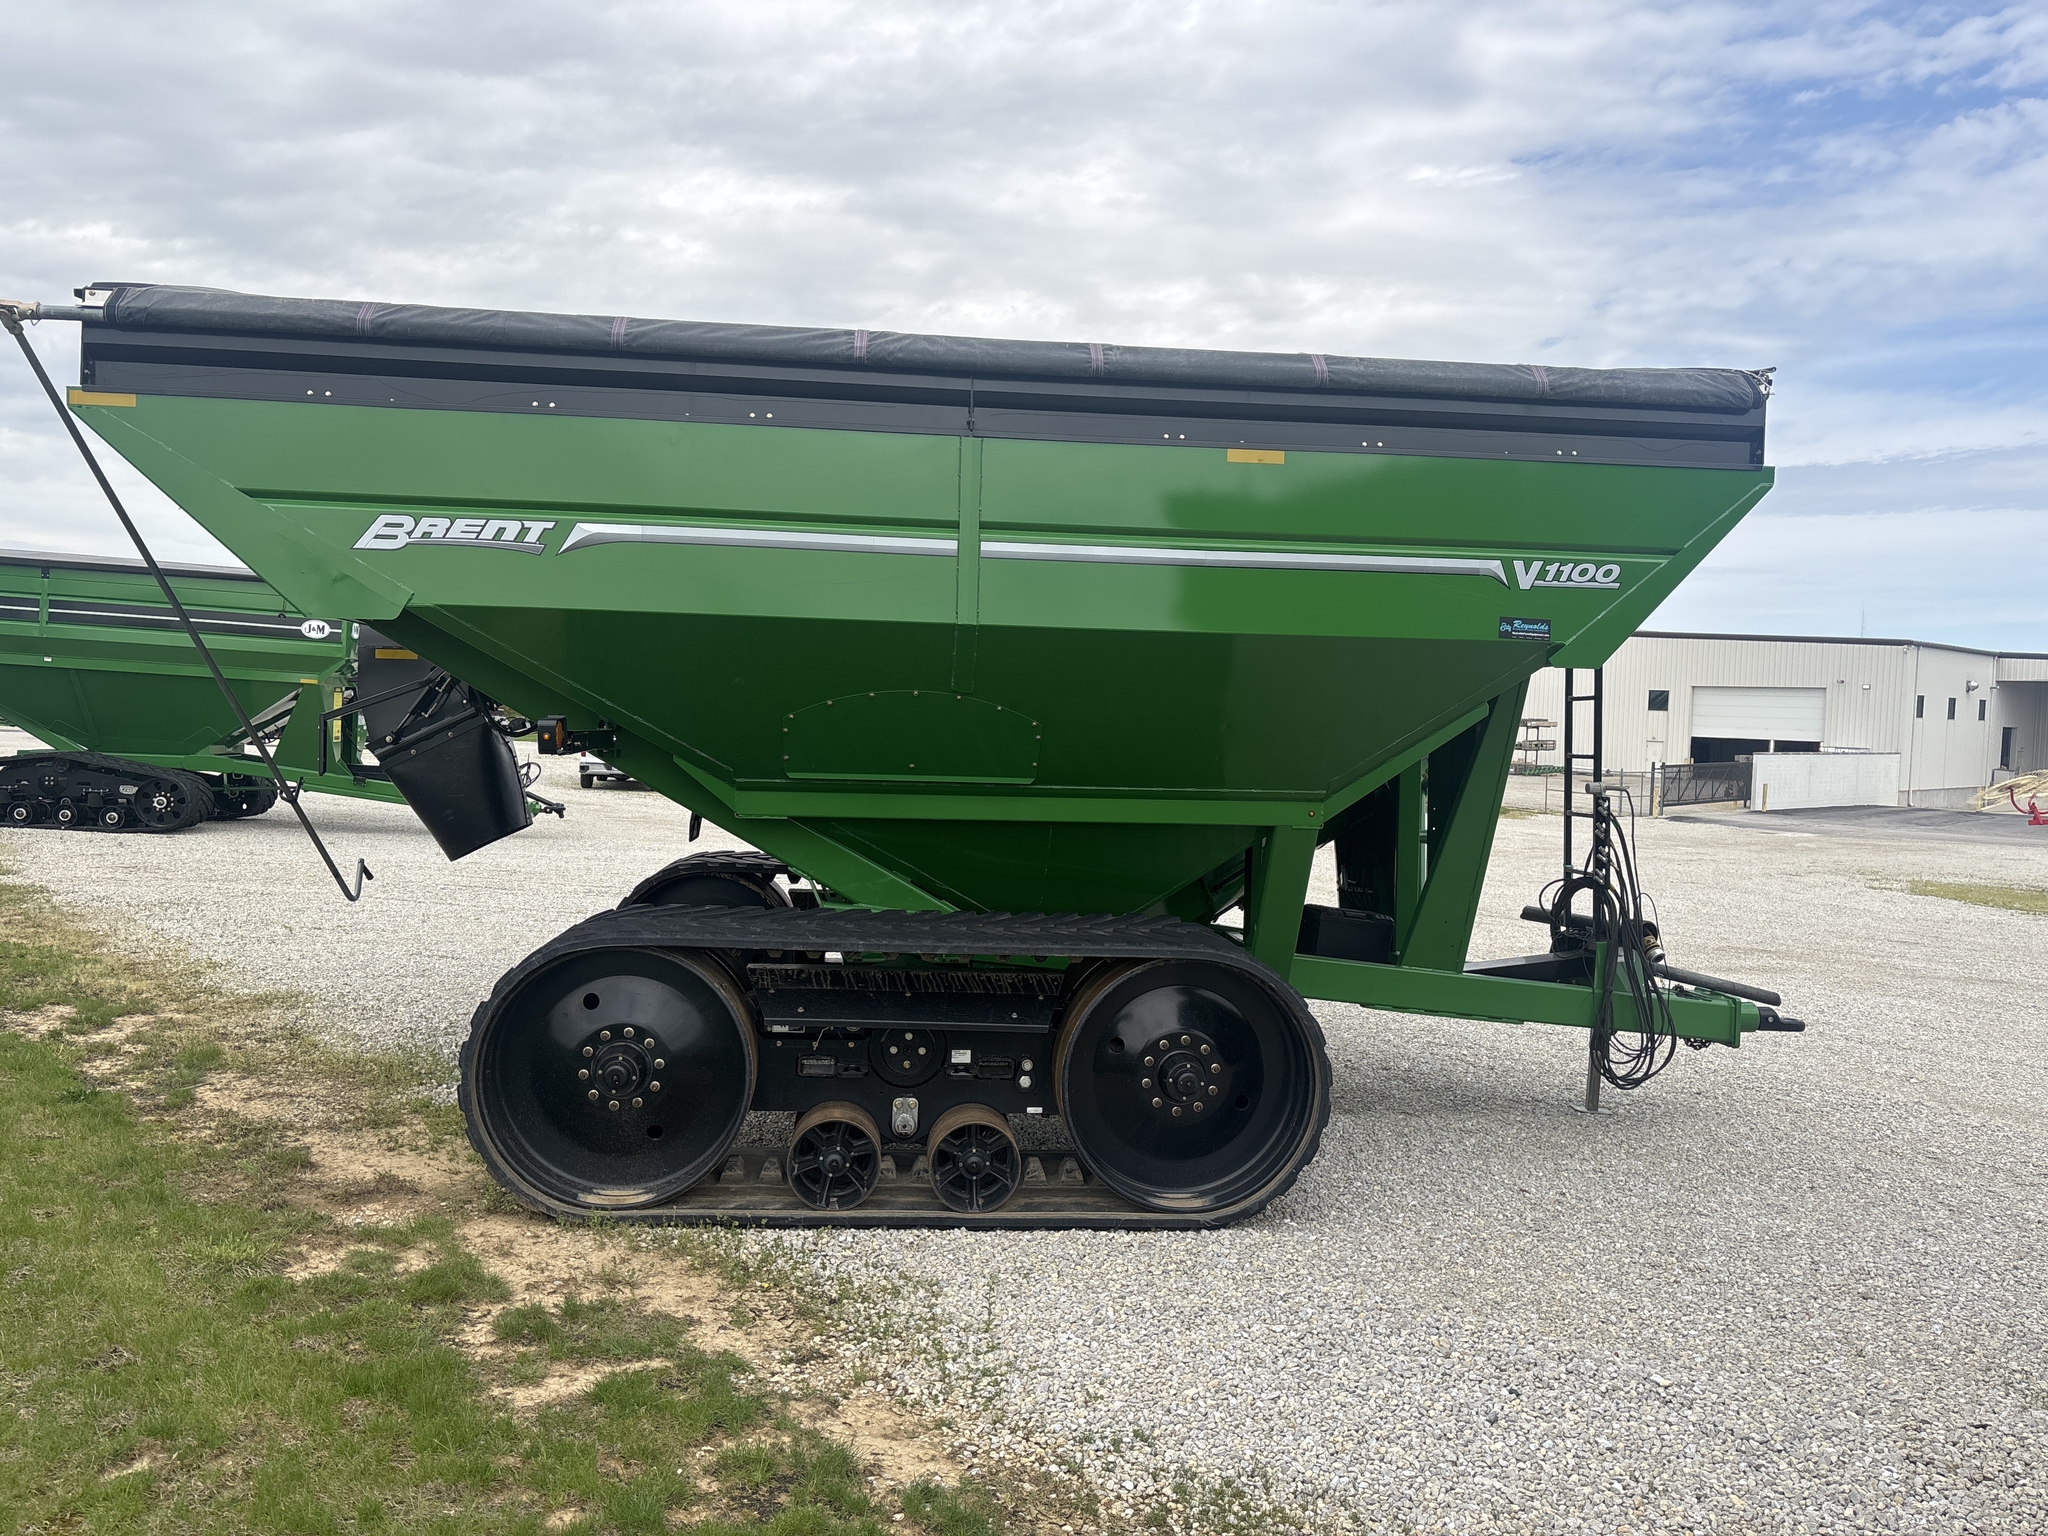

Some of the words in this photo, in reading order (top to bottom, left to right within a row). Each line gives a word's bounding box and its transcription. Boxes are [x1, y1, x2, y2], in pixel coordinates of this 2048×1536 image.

[351, 513, 558, 551] BRENT
[1512, 559, 1621, 591] V1100
[304, 623, 326, 635] J&M
[1512, 620, 1549, 631] Reynolds
